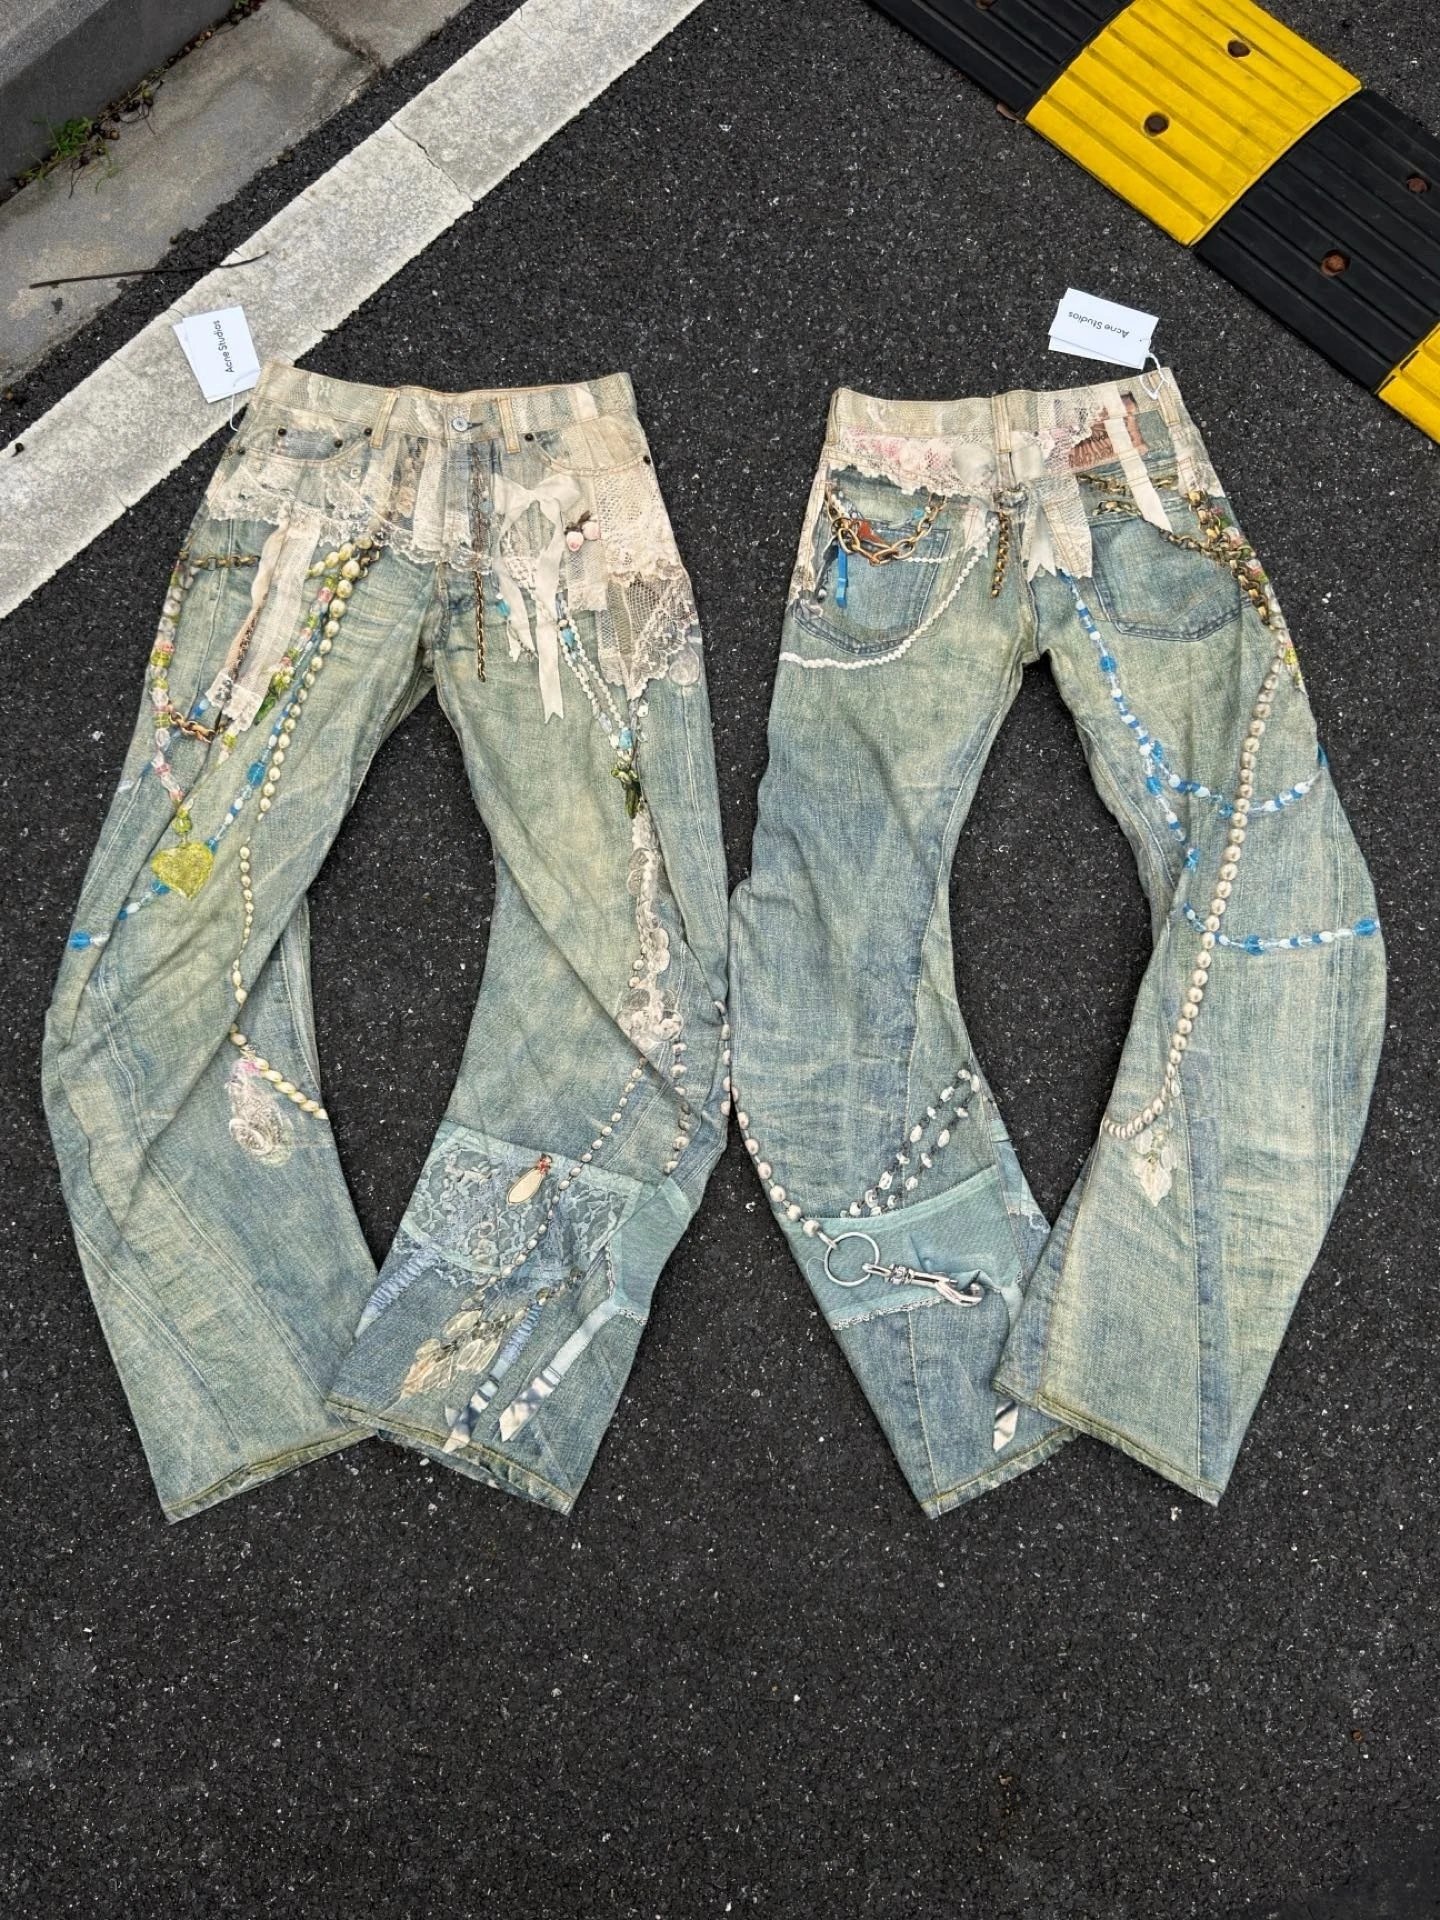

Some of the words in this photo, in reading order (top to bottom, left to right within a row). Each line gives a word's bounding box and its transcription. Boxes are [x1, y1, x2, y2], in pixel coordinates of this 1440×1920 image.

[1068, 311, 1103, 330] Studios
[213, 320, 228, 351] Studios
[1104, 324, 1130, 338] Acne
[222, 351, 235, 373] Acne
